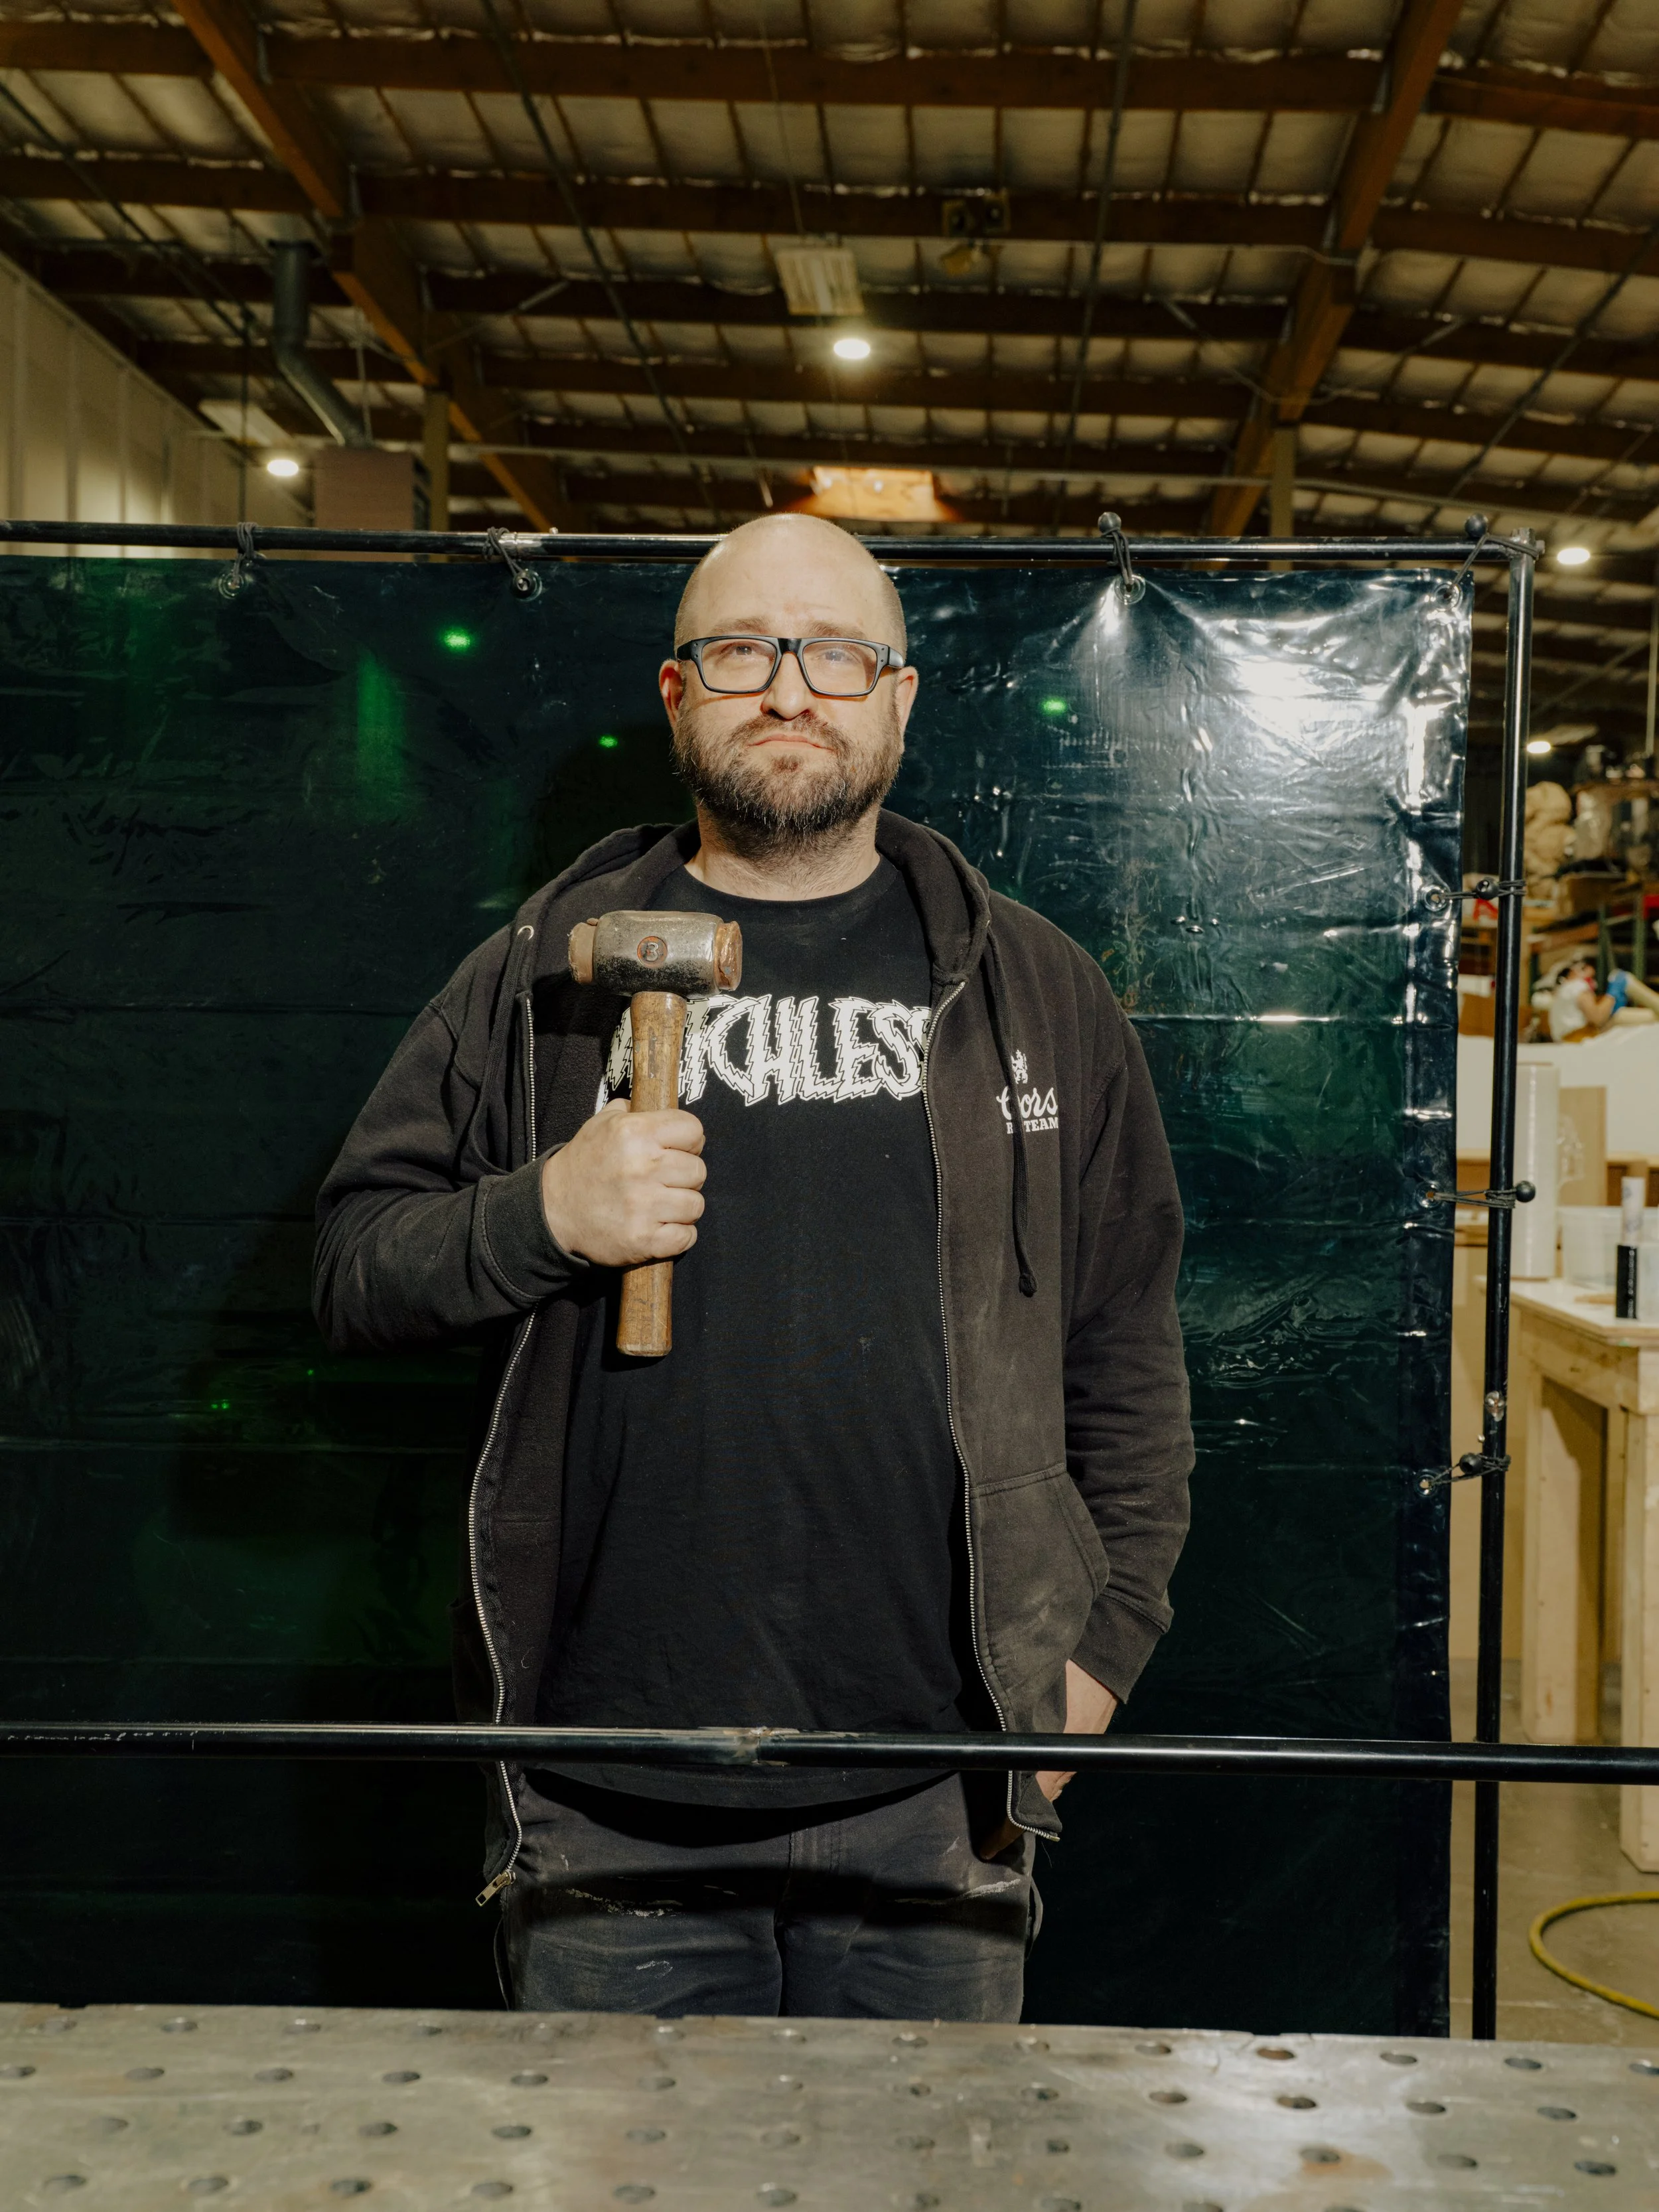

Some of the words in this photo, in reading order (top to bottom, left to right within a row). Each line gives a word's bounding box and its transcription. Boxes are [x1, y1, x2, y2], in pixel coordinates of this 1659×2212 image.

[646, 942, 658, 962] 3
[996, 1086, 1058, 1120] Cors
[1024, 1117, 1058, 1132] TEAM
